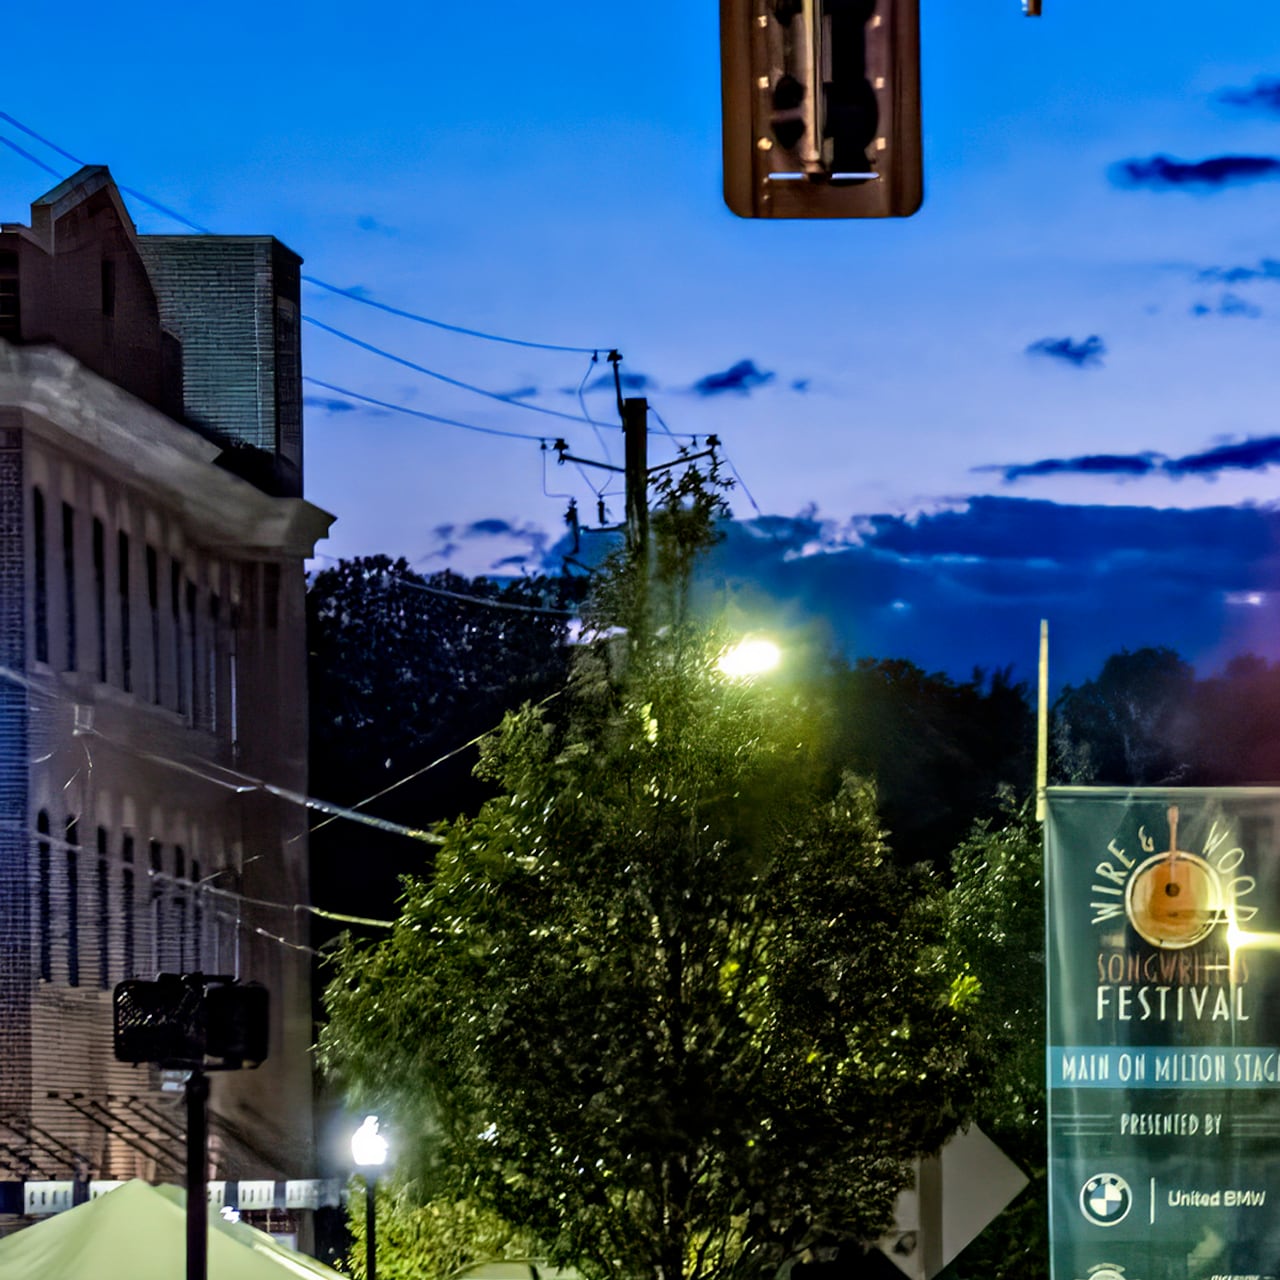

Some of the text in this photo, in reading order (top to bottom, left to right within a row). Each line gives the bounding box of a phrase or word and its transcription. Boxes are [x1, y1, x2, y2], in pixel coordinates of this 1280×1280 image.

[1090, 838, 1137, 925] WIRE
[1201, 820, 1259, 922] WOOD
[1097, 985, 1250, 1022] FESTIVAL
[1062, 1053, 1109, 1082] MAIN
[1118, 1053, 1145, 1082] ON
[1155, 1053, 1226, 1082] MILTON
[1120, 1113, 1222, 1135] PRESENTED BY
[1168, 1189, 1267, 1207] United BMW
